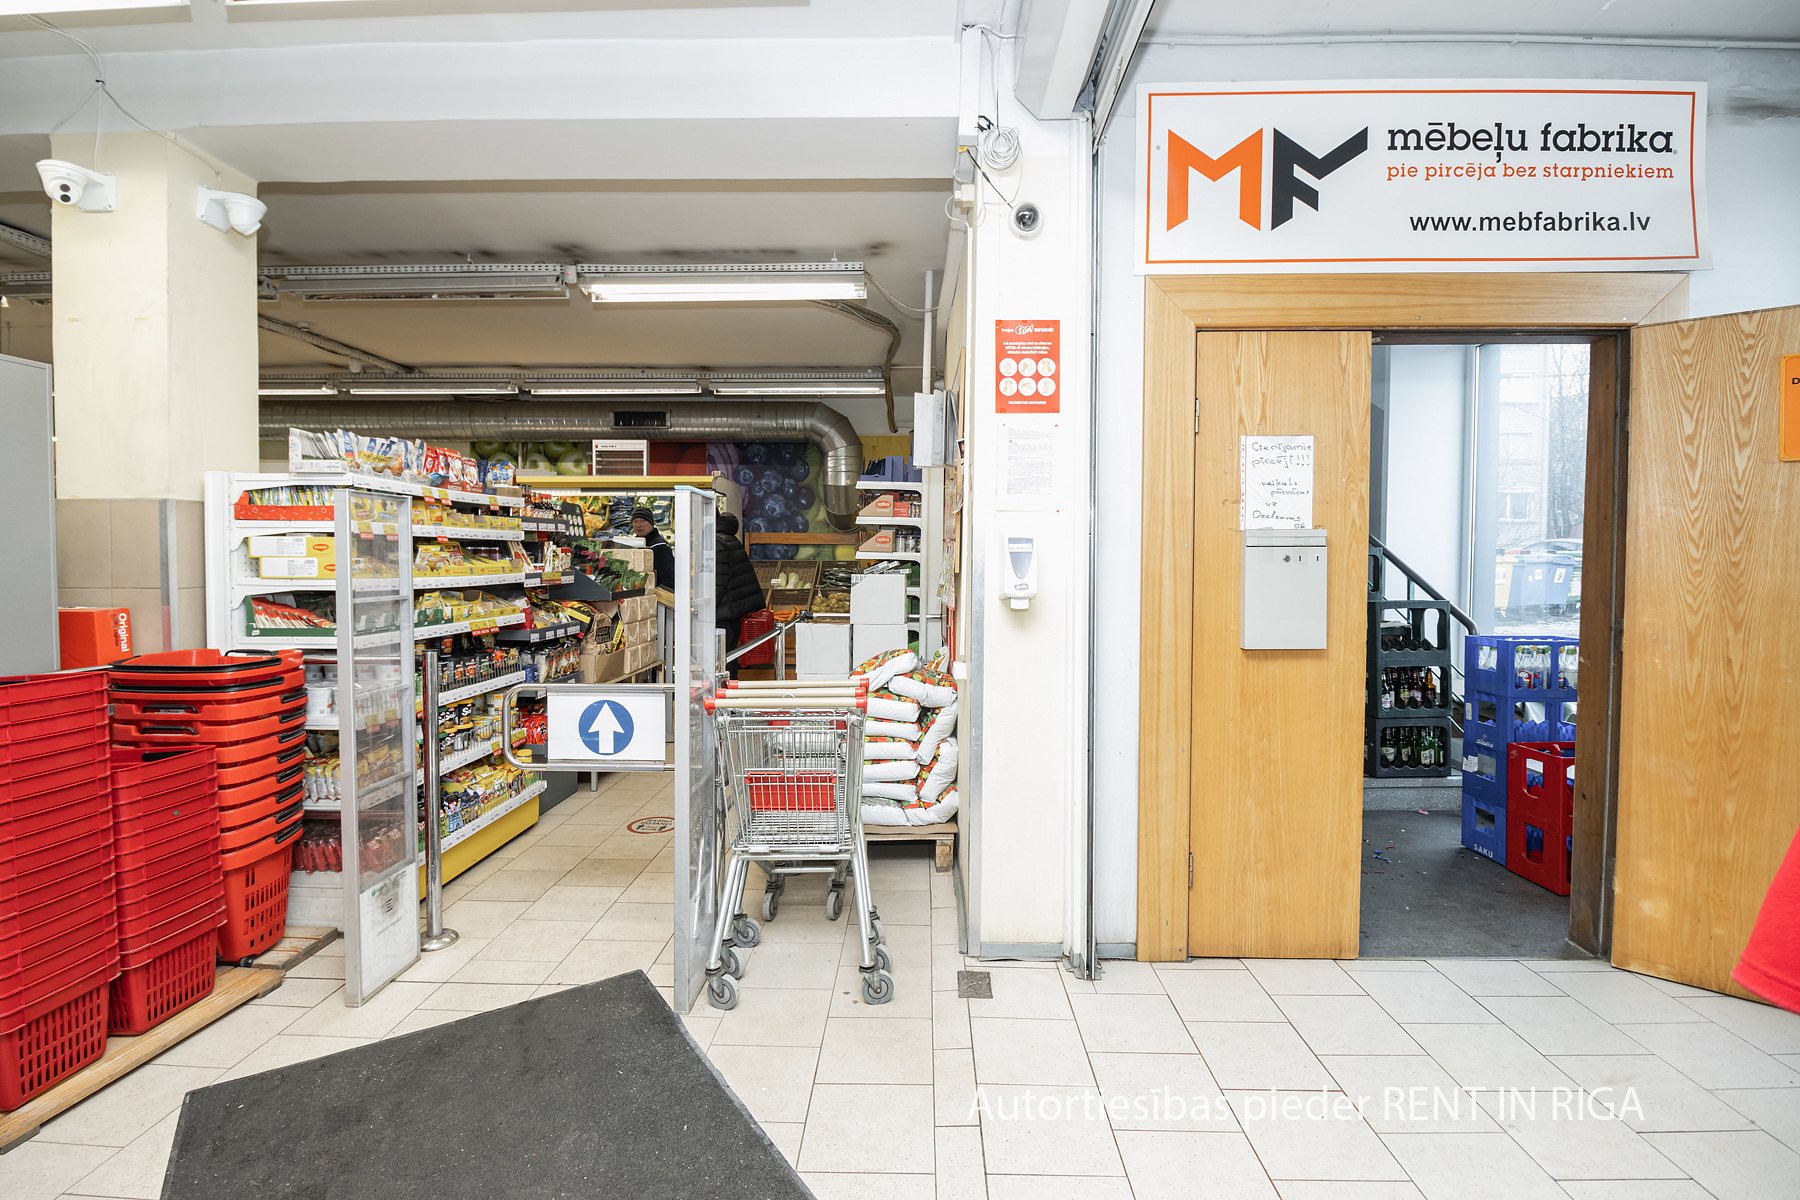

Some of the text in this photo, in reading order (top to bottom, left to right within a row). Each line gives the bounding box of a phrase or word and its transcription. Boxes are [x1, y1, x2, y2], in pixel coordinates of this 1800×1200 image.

[1387, 122, 1674, 163] mēbeļu fabrika
[1387, 161, 1675, 182] pie pircēja bez starpniekiem
[1409, 211, 1651, 232] www.mebfabrika.lv
[118, 612, 130, 652] Original
[1473, 843, 1494, 858] SAKU
